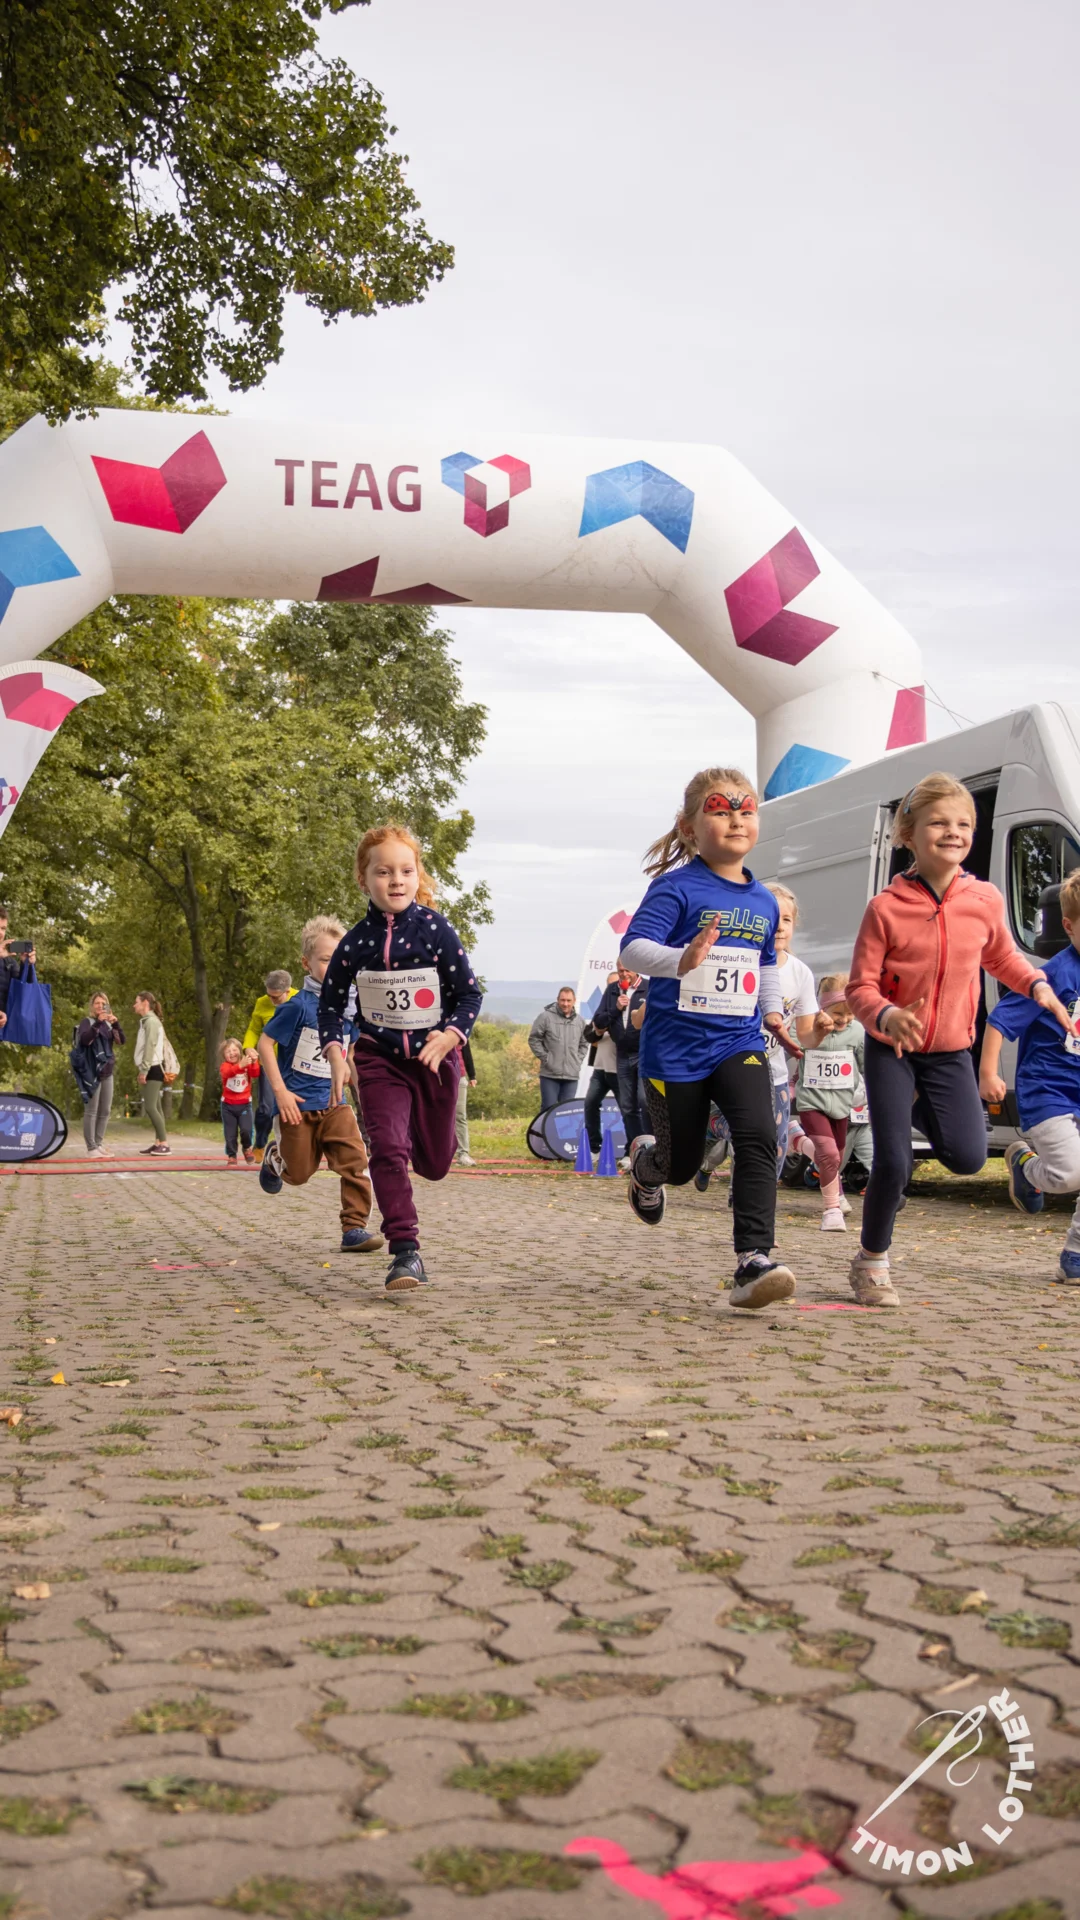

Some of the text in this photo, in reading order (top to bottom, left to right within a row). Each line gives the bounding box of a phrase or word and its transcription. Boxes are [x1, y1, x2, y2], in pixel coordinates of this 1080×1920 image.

[274, 458, 422, 512] TEAG
[697, 908, 770, 934] saller
[588, 960, 614, 971] TEAG
[704, 954, 739, 963] mberglauf
[368, 975, 426, 986] Limberglauf Ranis
[714, 968, 739, 993] 51
[385, 989, 411, 1011] 33
[816, 1062, 840, 1077] 150
